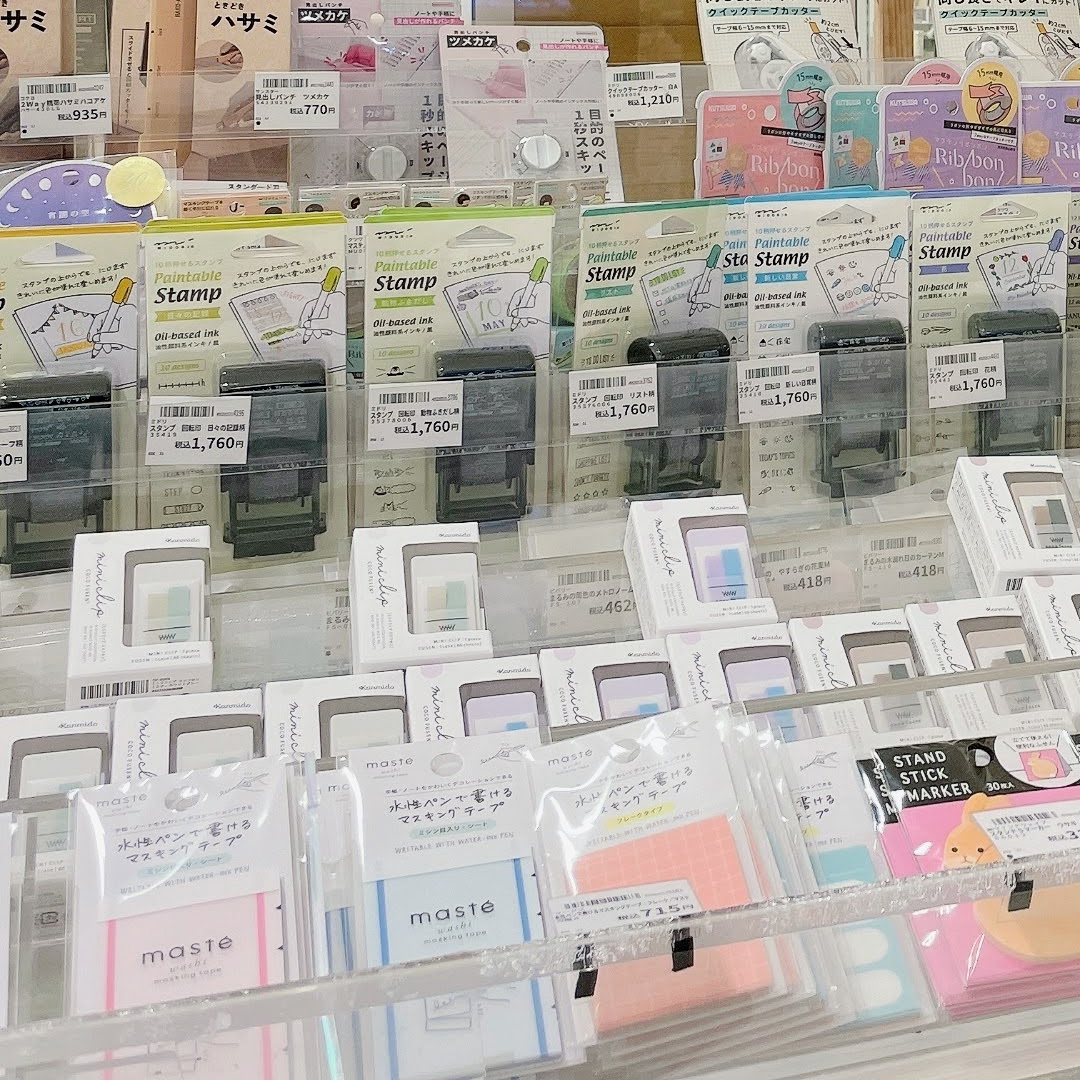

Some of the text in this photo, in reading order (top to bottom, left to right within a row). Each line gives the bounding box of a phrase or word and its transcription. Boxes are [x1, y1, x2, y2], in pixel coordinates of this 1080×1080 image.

[214, 1, 245, 11] ときどき
[708, 6, 819, 17] クイックテープカッター
[300, 9, 350, 22] ツメカケ
[940, 9, 1047, 19] クイックテープカッター
[211, 13, 279, 34] ハサミ
[449, 36, 497, 47] ツメカケ
[628, 94, 679, 107] 税込1,210円
[58, 109, 107, 120] 税込935円
[290, 105, 336, 114] 税込770円
[755, 236, 809, 249] Paintable
[920, 231, 973, 243] Paintable
[587, 249, 638, 264] Paintable
[755, 252, 809, 267] Stamp
[919, 245, 972, 260] Stamp
[374, 259, 437, 272] Paintable
[154, 270, 222, 284] Paintable
[586, 265, 636, 282] Stamp
[374, 275, 437, 291] Stamp
[918, 283, 954, 293] Oil-based
[154, 287, 222, 304] Stamp
[755, 291, 807, 301] Oil-based ink
[583, 305, 631, 318] Oil-based ink
[373, 317, 433, 328] Oil-based ink
[155, 330, 219, 341] Oil-based ink
[930, 370, 954, 379] スタンプ
[739, 385, 760, 393] スタンプ
[950, 377, 1002, 392] 税込1,760円
[572, 396, 597, 404] スタンプ
[761, 391, 817, 407] 税込1,760円
[371, 411, 393, 419] スタンプ
[595, 403, 655, 419] 税込1,760円
[394, 421, 459, 436] 税込1,760円
[175, 437, 244, 452] 税込1,760円
[654, 517, 676, 578] miniclip
[898, 564, 945, 579] 税込418円
[783, 576, 832, 592] 税込418円
[893, 749, 947, 768] STAND
[900, 766, 949, 785] STICK
[909, 781, 973, 803] MARKER
[389, 787, 513, 814] 水性ペンで書ける
[398, 801, 506, 825] マスキングテープ
[410, 899, 496, 927] masté
[141, 934, 234, 966] masté
